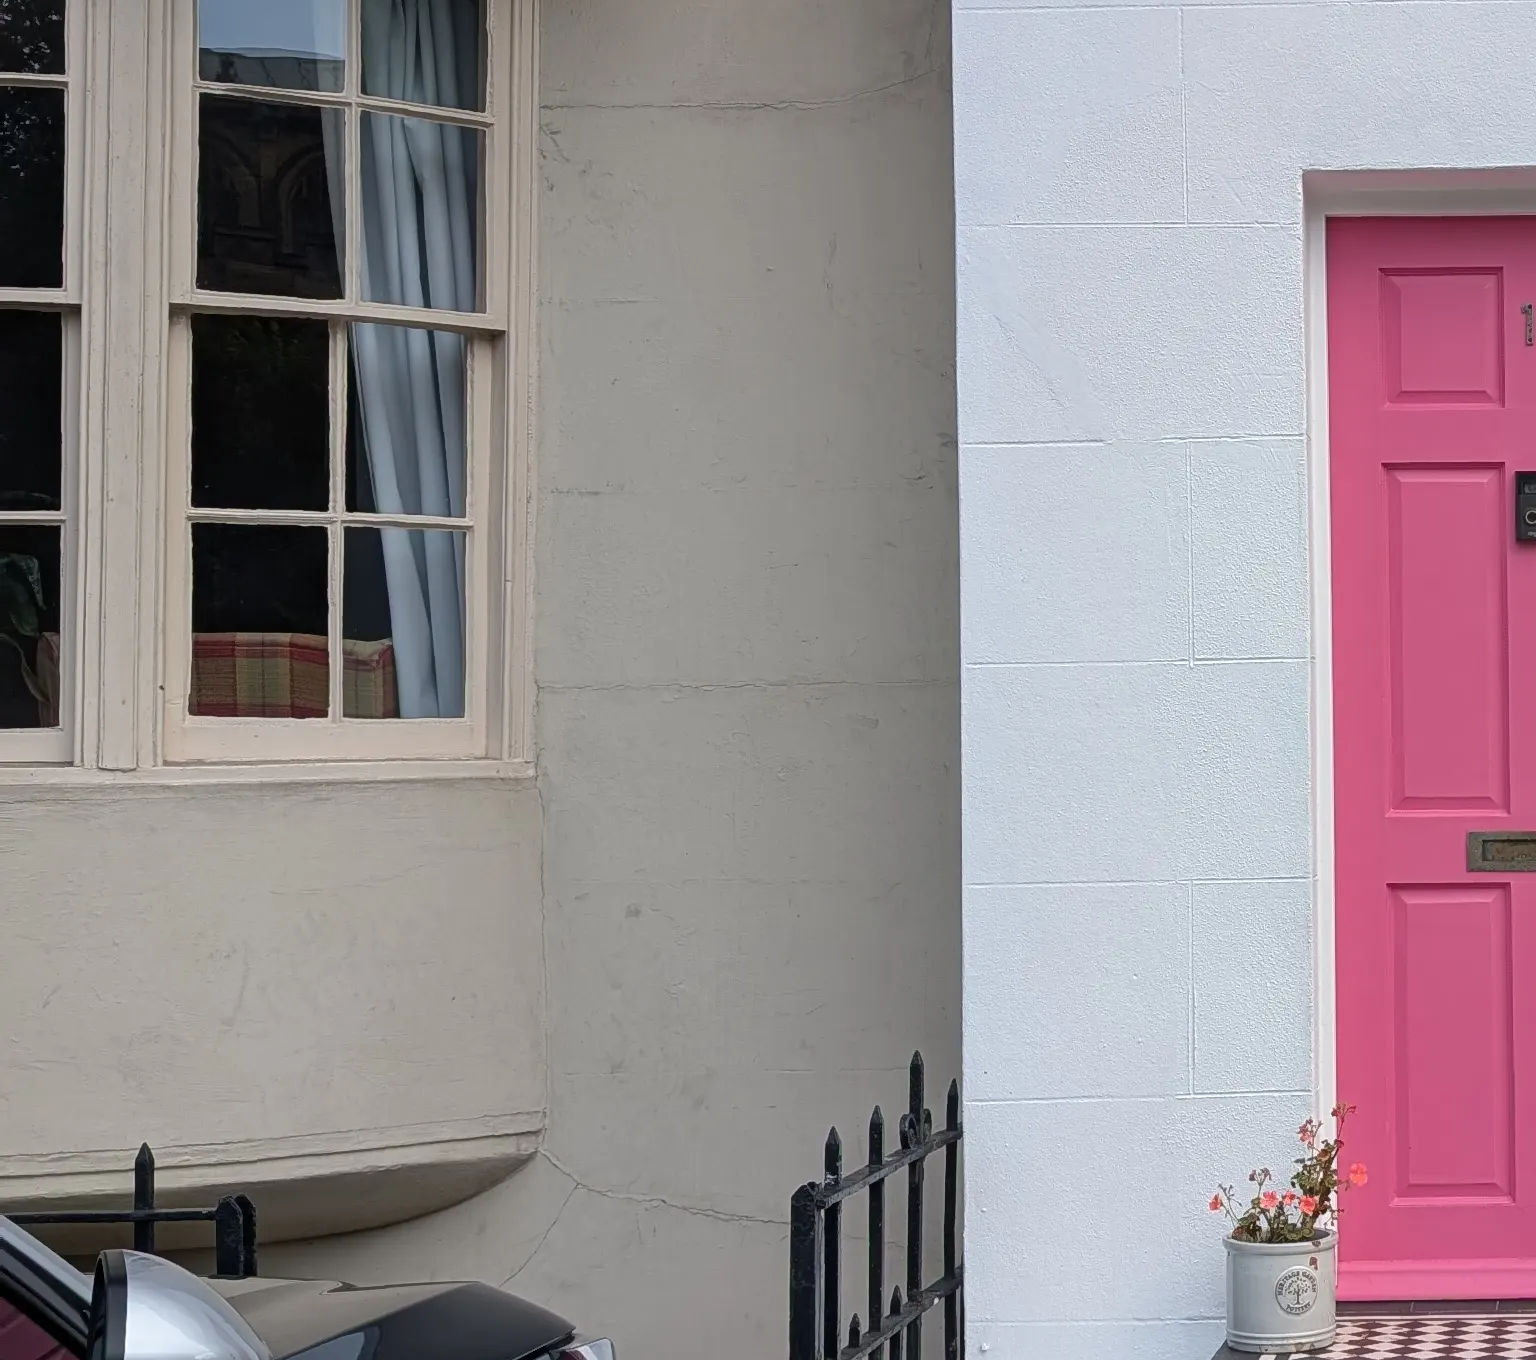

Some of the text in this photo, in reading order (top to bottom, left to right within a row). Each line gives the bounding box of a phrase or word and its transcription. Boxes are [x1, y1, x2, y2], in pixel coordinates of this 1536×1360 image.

[1520, 303, 1534, 346] 1
[1277, 1270, 1317, 1296] HERITAGE GARDEN
[1285, 1301, 1311, 1312] POTTERY
